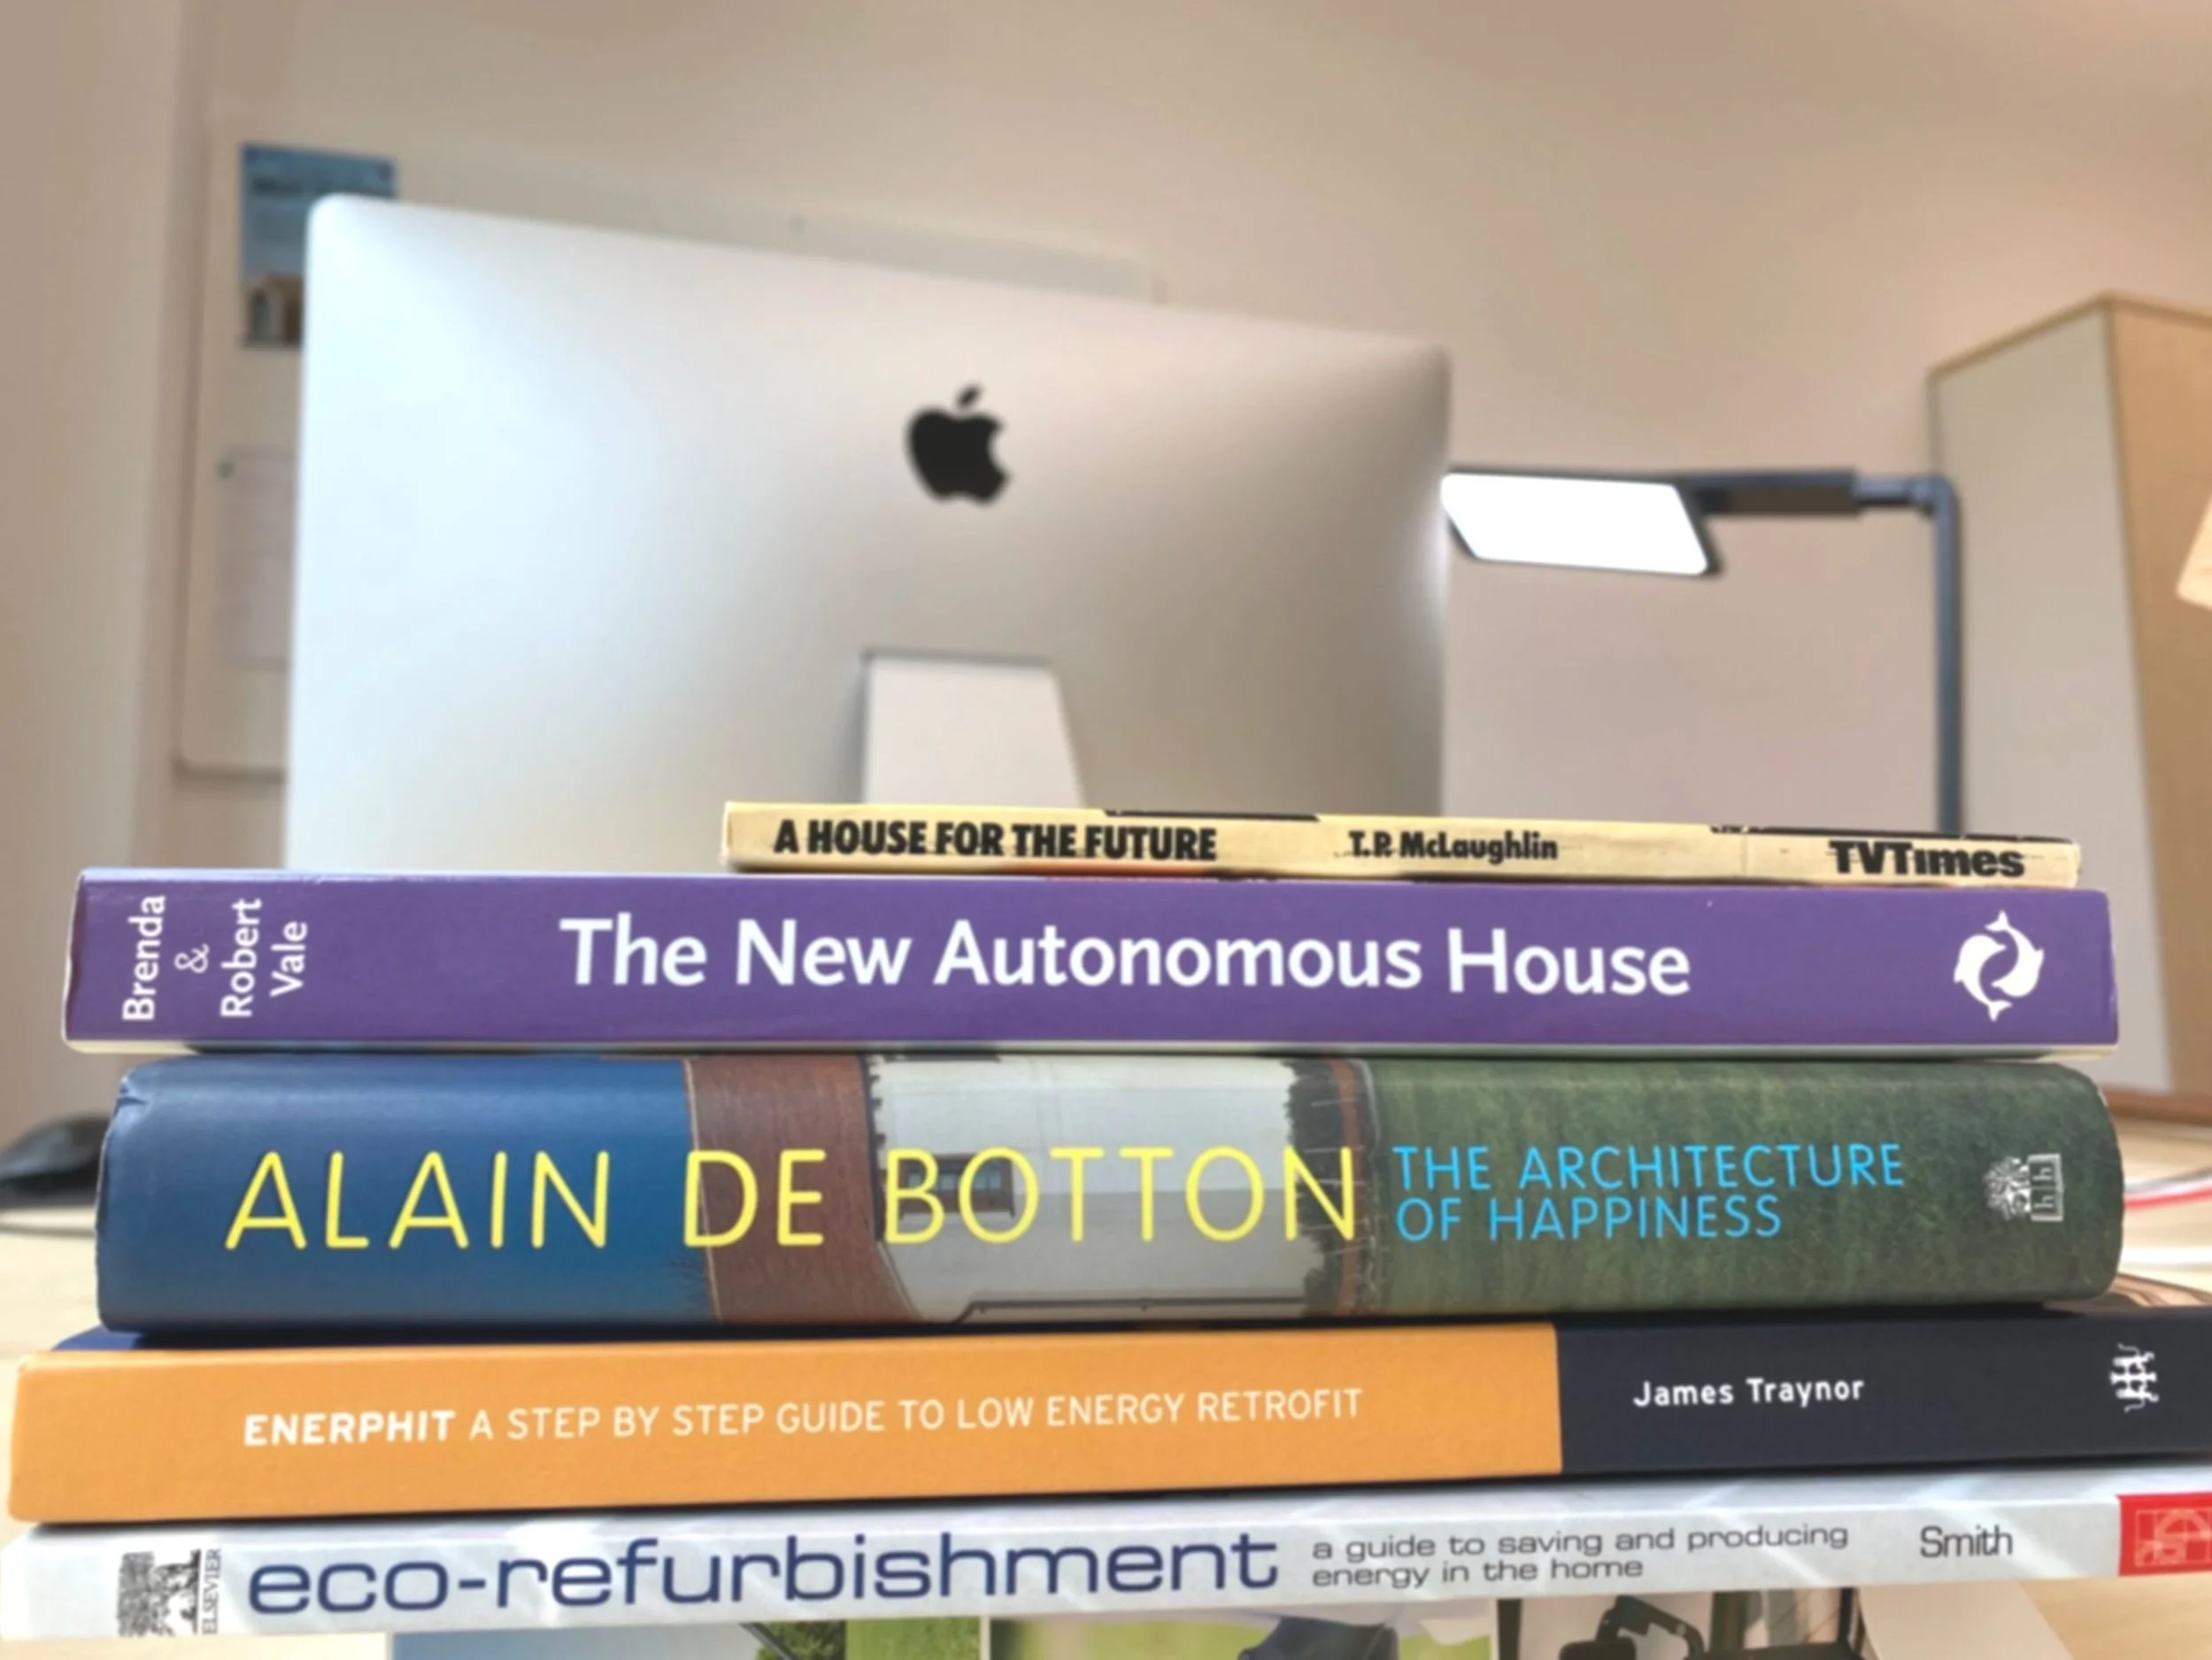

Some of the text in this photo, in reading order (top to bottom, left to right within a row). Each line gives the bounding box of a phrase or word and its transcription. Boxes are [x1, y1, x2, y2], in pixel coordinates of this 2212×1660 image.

[774, 820, 1217, 861] A HOUSE FOR THE FUTURE
[1399, 830, 1558, 865] McLaughlin
[122, 894, 166, 1021] Brenda
[174, 944, 209, 972] &
[220, 898, 262, 1017] Robert
[270, 921, 307, 997] Vale
[559, 913, 1692, 997] The New Autonomous House
[1392, 1143, 1905, 1191] THE ARCHITECTURE
[225, 1146, 1355, 1249] ALAIN DE BOTTON
[1396, 1195, 1783, 1241] OF HAPPINESS
[1632, 1375, 1865, 1408] James Traynor
[243, 1387, 1363, 1447] ENERPHIT A STEP BY STEP GUIDE TO LOW ENERGY RETROFIT
[1312, 1523, 1849, 1563] a guide to saving and producing
[1918, 1525, 2015, 1560] Smith
[202, 1548, 222, 1635] ELSEVIER
[248, 1532, 1279, 1615] eco-refurbishment
[1312, 1557, 1644, 1590] energy in the home
